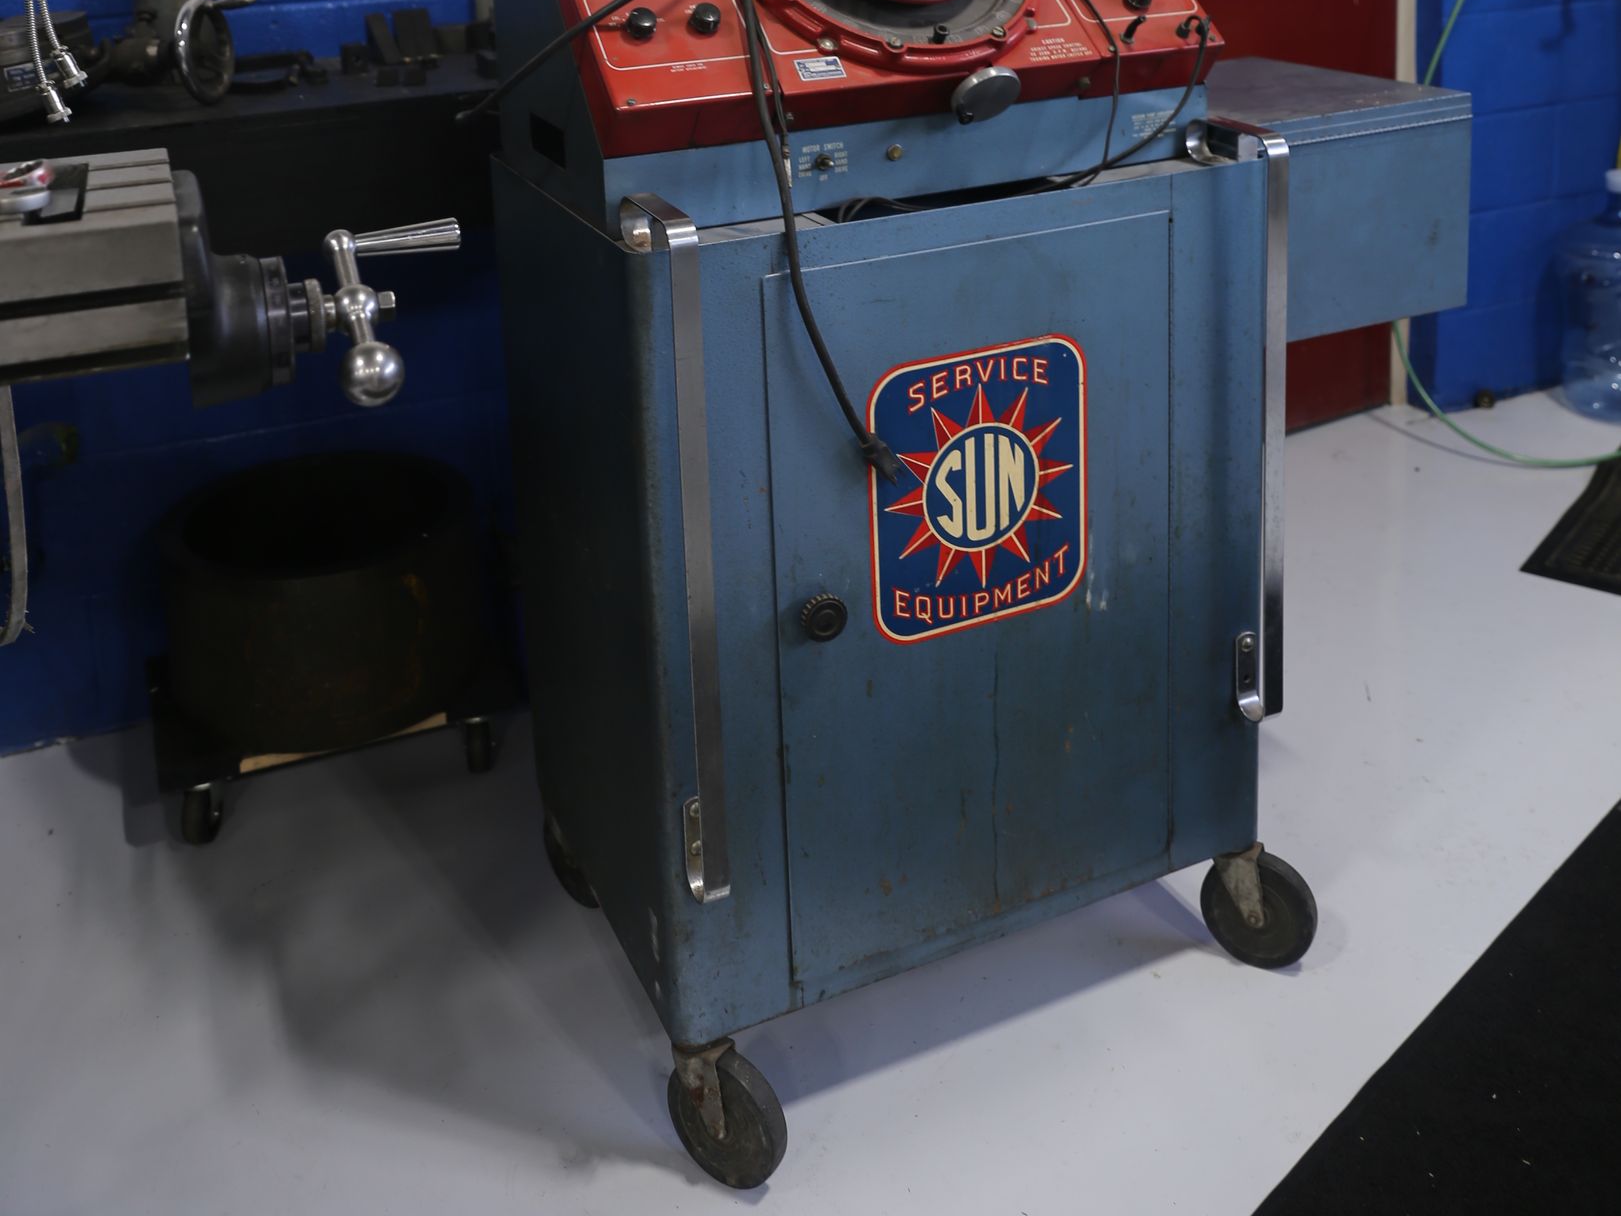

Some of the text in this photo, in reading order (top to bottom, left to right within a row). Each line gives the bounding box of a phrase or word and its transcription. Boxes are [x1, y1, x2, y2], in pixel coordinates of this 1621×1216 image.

[907, 357, 1049, 413] SERVICE
[934, 432, 1026, 542] SUN
[892, 543, 1070, 624] EQUIPMENT
